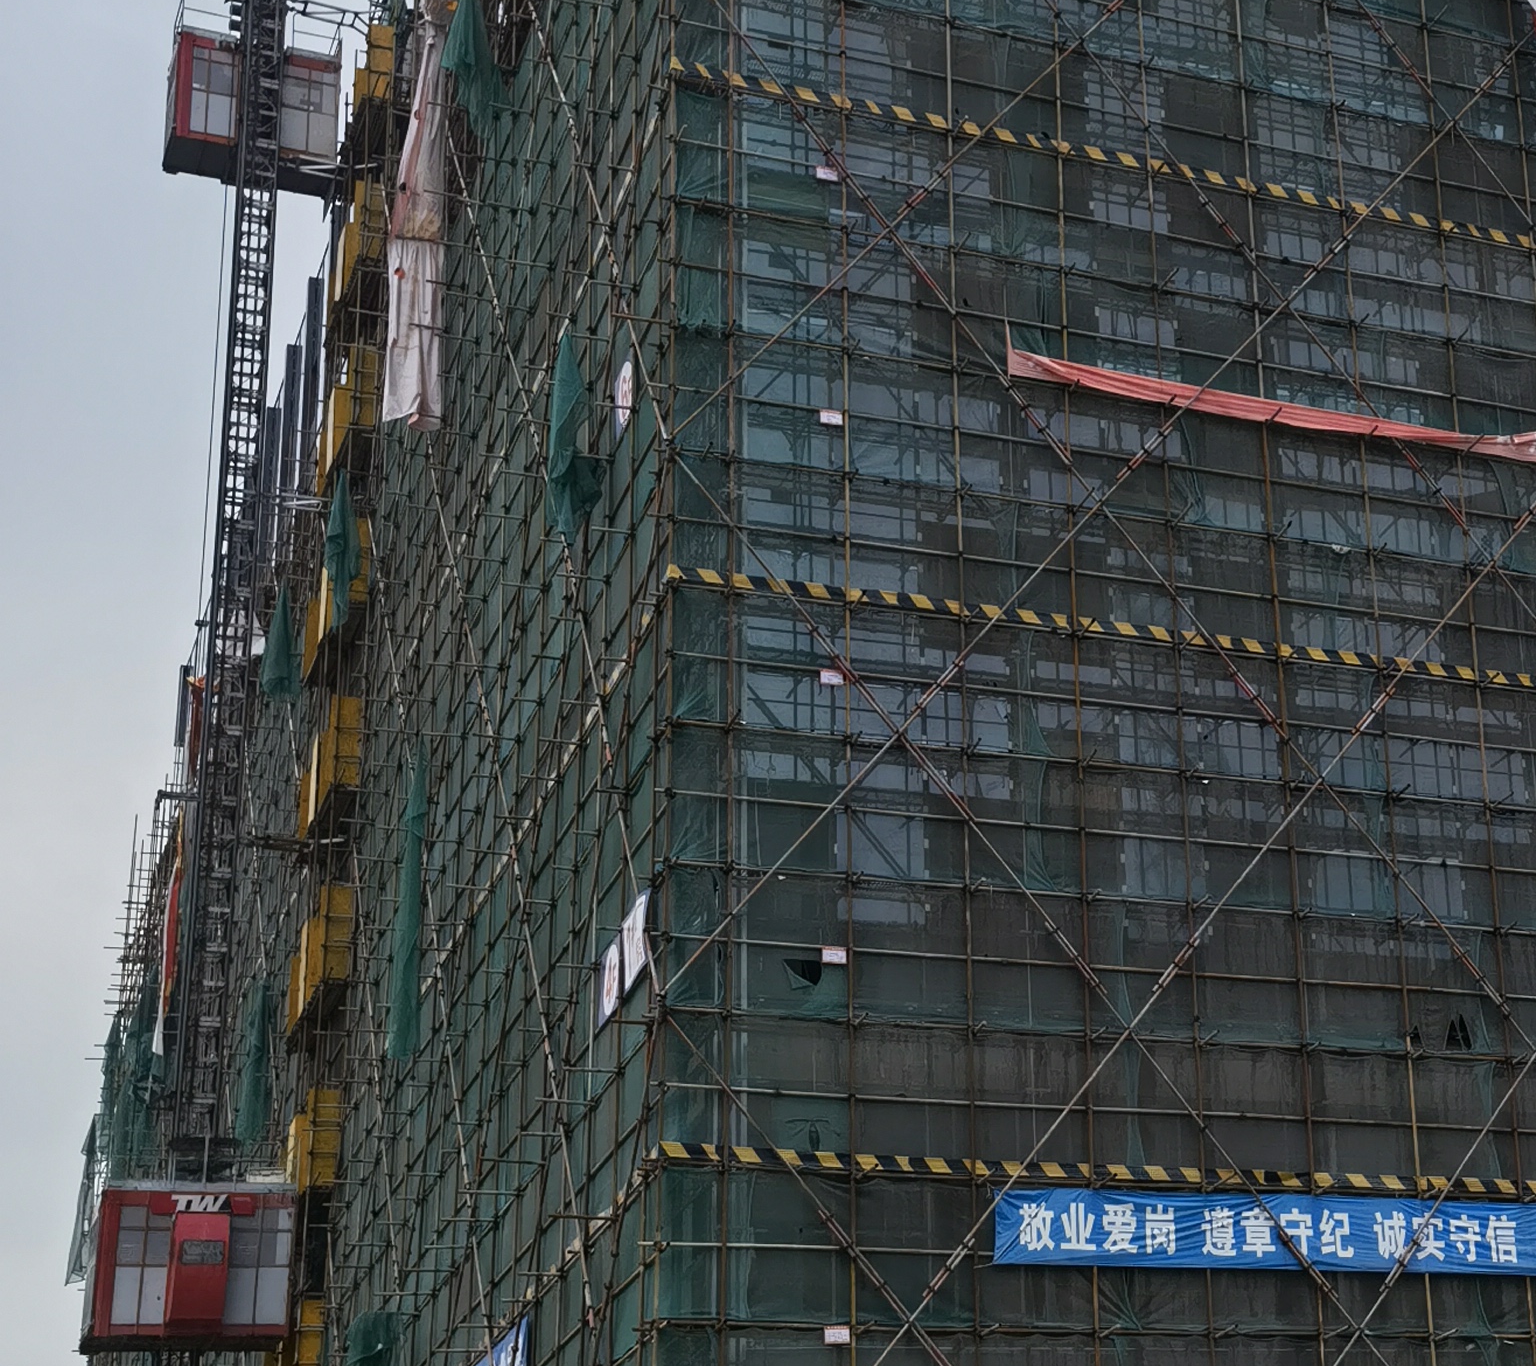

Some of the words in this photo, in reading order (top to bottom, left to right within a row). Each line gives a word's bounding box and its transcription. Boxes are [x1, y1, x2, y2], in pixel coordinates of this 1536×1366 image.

[1018, 1201, 1177, 1254] 敬业爱岗
[1200, 1206, 1354, 1259] 遵章守纪
[1374, 1210, 1518, 1265] 诚实守信
